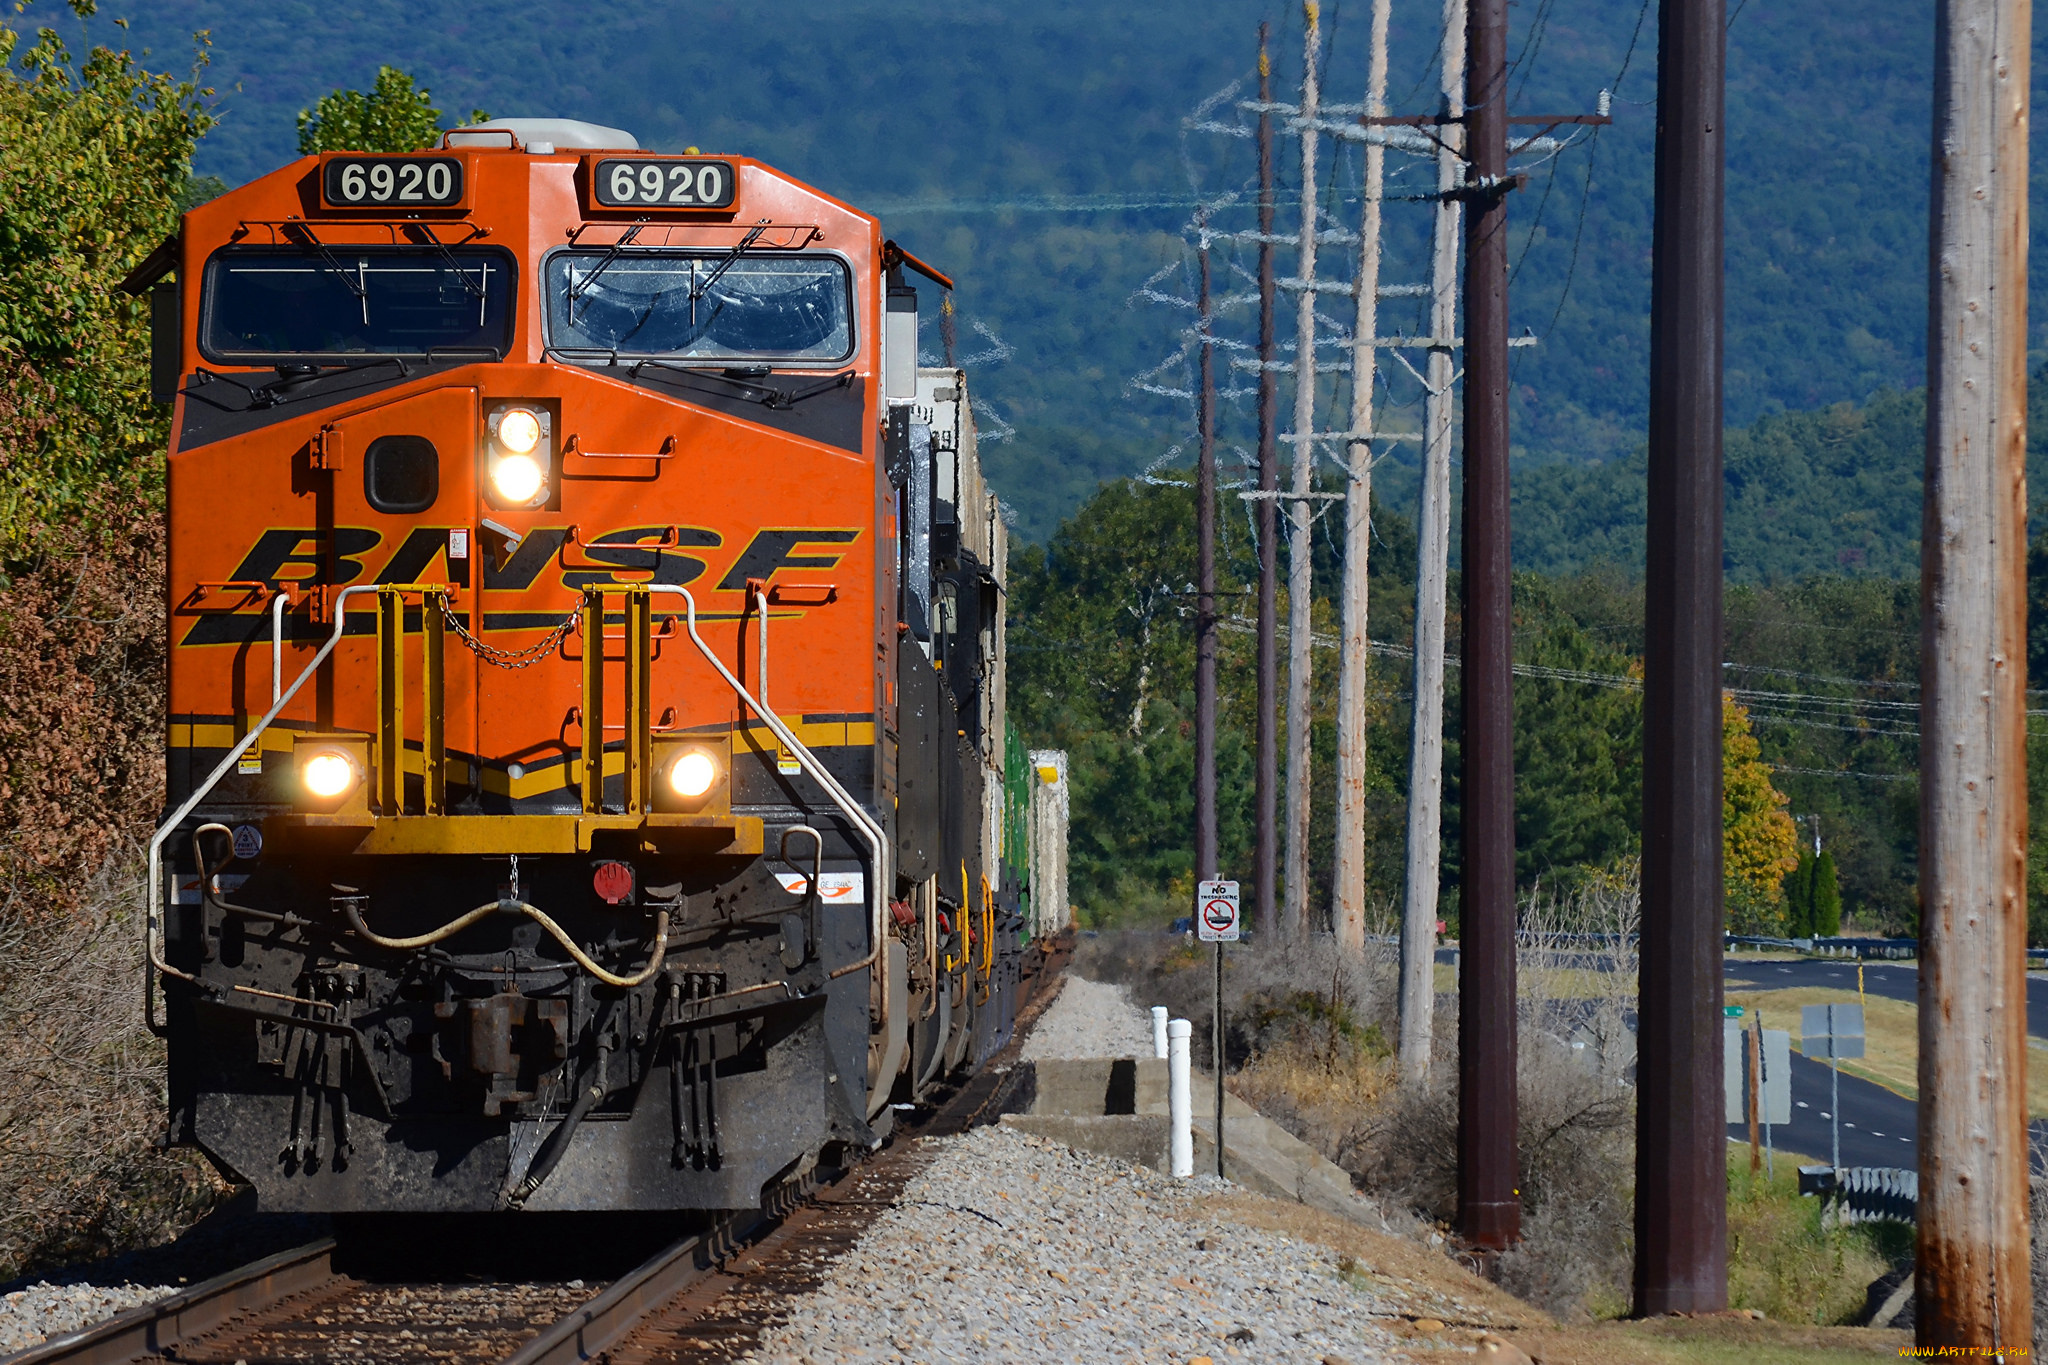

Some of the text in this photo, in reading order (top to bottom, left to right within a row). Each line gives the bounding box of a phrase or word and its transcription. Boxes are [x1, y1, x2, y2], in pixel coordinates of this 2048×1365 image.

[342, 163, 452, 201] 6920
[611, 164, 722, 203] 6920
[219, 526, 863, 593] BNSF
